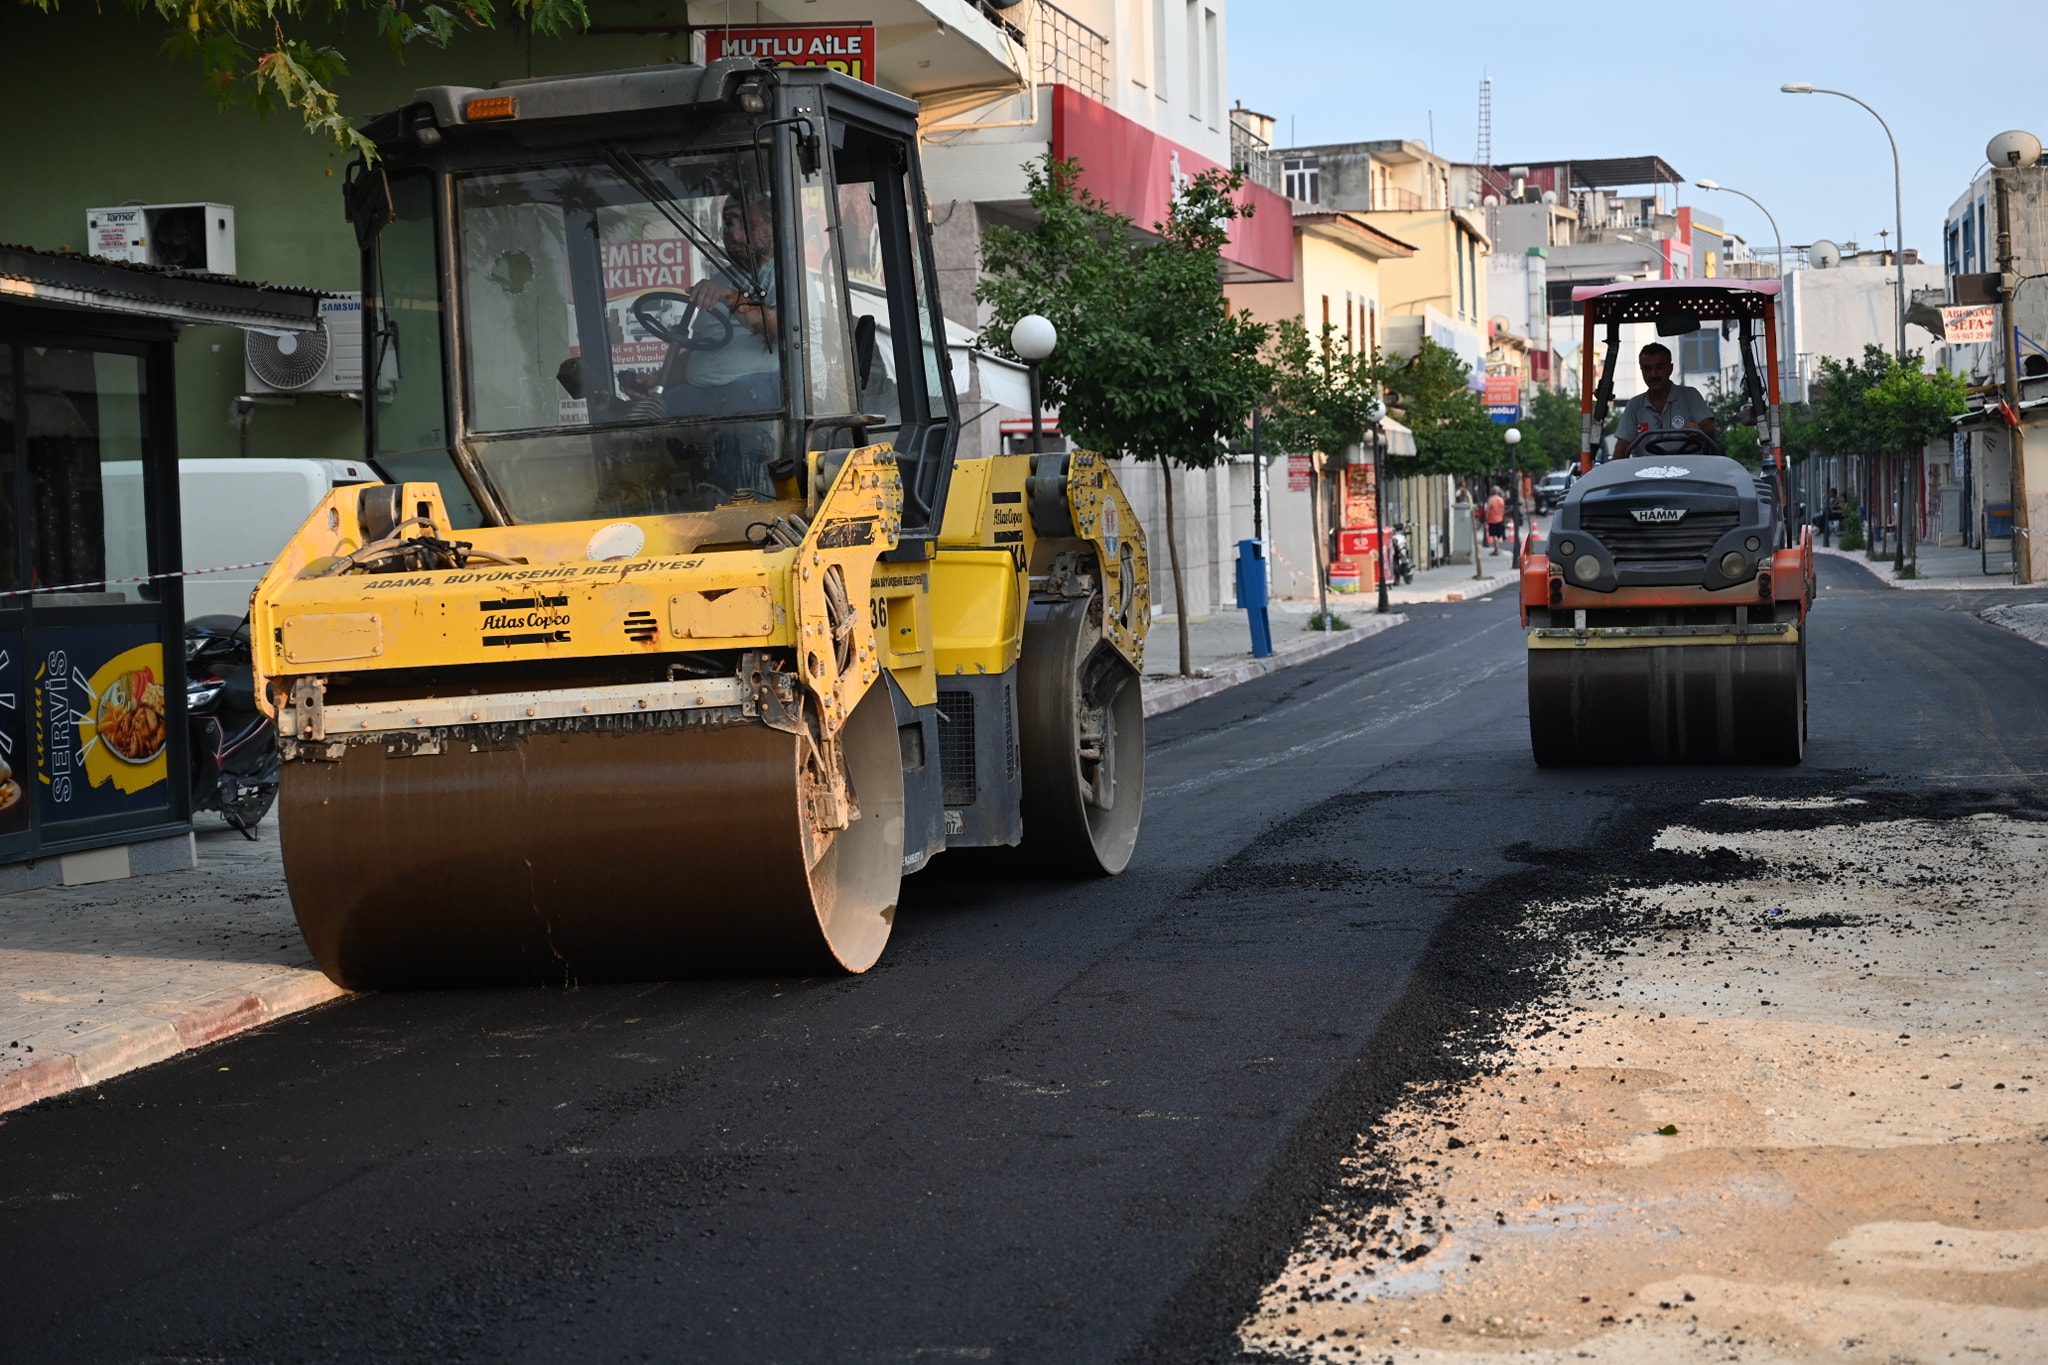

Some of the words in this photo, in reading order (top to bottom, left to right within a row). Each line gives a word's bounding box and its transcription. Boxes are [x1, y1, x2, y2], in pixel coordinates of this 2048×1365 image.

[721, 37, 803, 57] MUTLU
[321, 302, 361, 311] SAMSUN
[1639, 510, 1678, 521] HAMM
[364, 577, 432, 591] ADANA
[443, 565, 578, 585] BÜYÜKŞEHİR
[582, 558, 706, 576] BELEDİYESİ
[481, 614, 525, 630] Atlas
[527, 612, 571, 629] Copco
[45, 650, 72, 802] SERVİS
